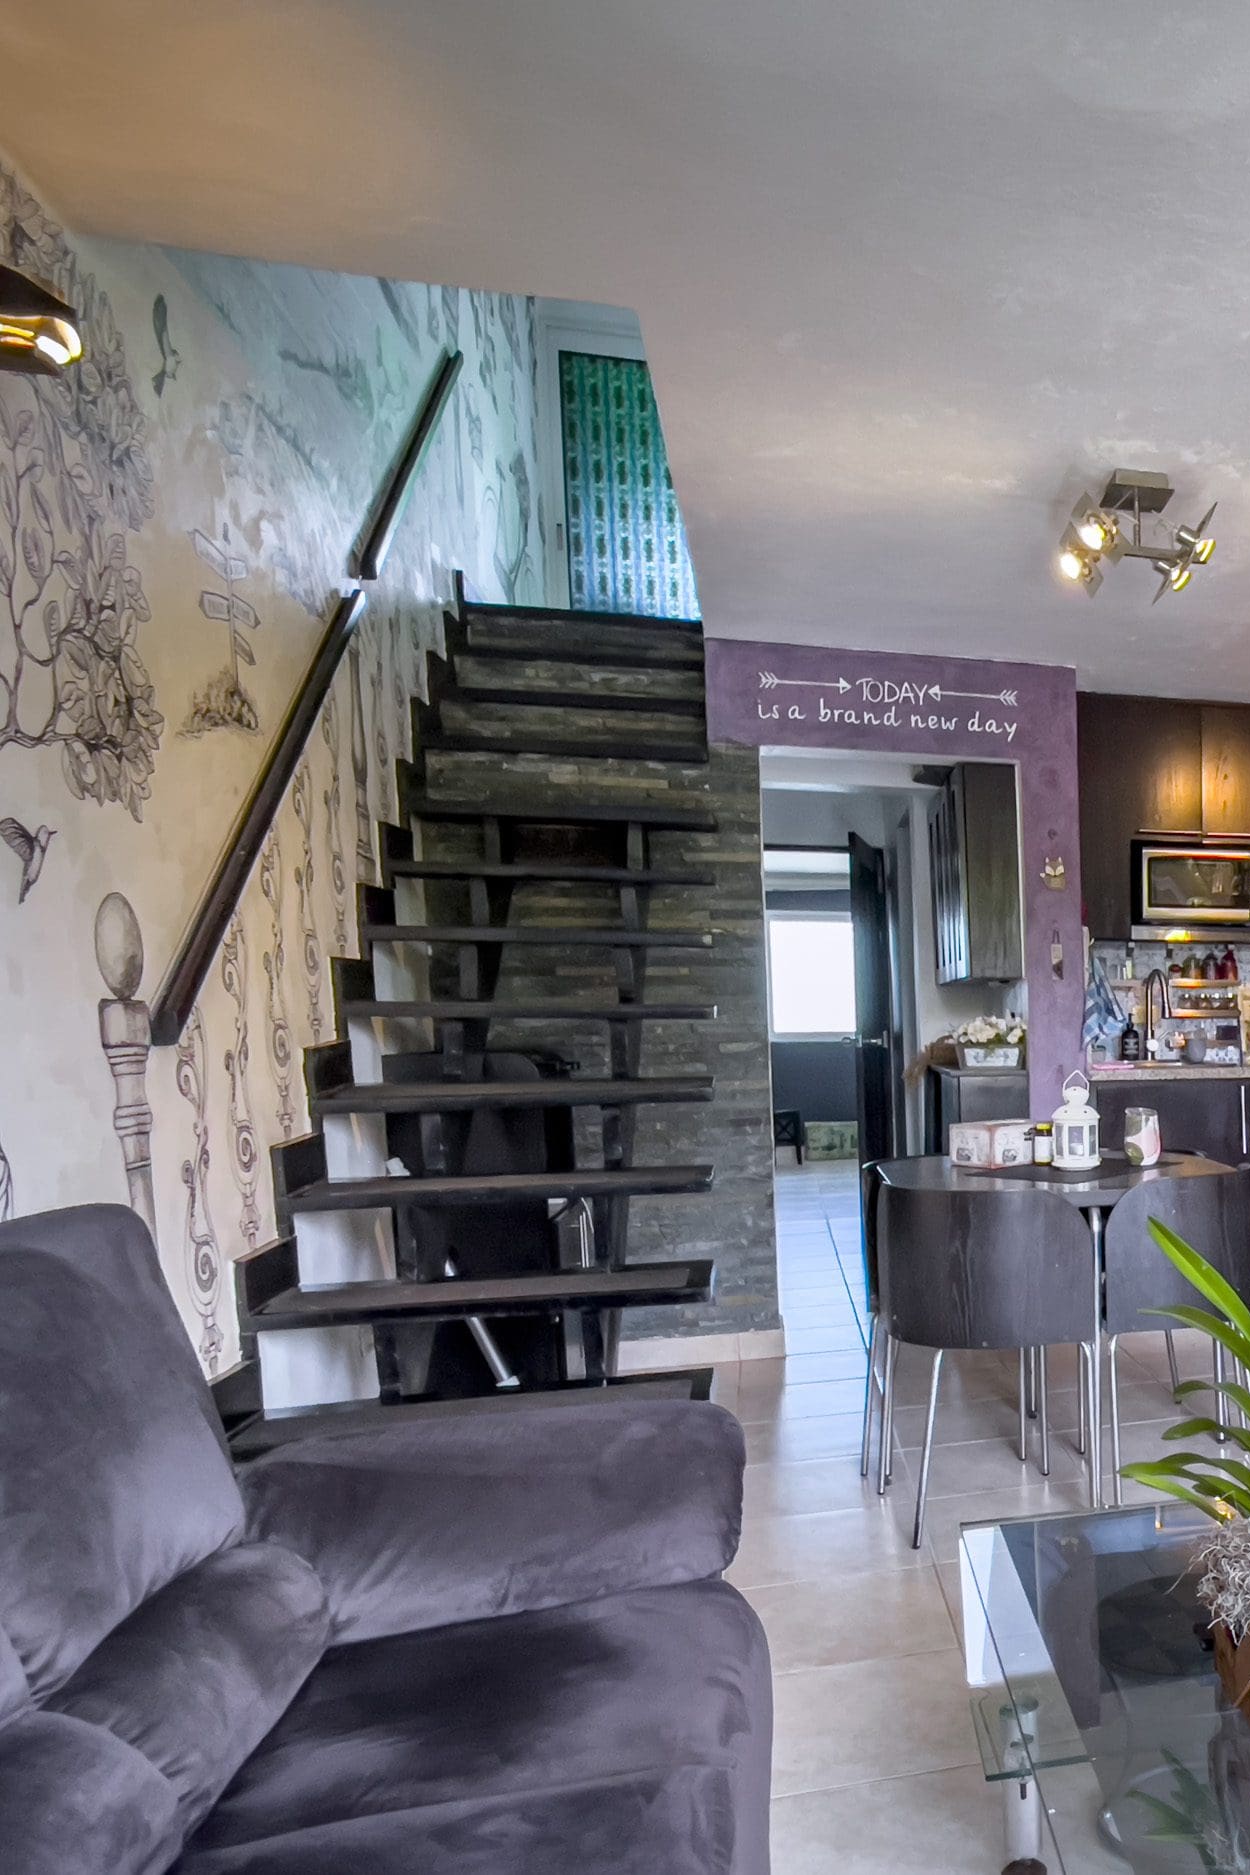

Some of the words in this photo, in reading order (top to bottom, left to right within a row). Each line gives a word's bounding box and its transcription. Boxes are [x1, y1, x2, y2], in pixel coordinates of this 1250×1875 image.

[856, 678, 928, 705] TODAY
[757, 699, 780, 719] is
[788, 705, 806, 720] a
[819, 698, 902, 727] brand
[910, 714, 959, 731] new
[967, 711, 1017, 742] day
